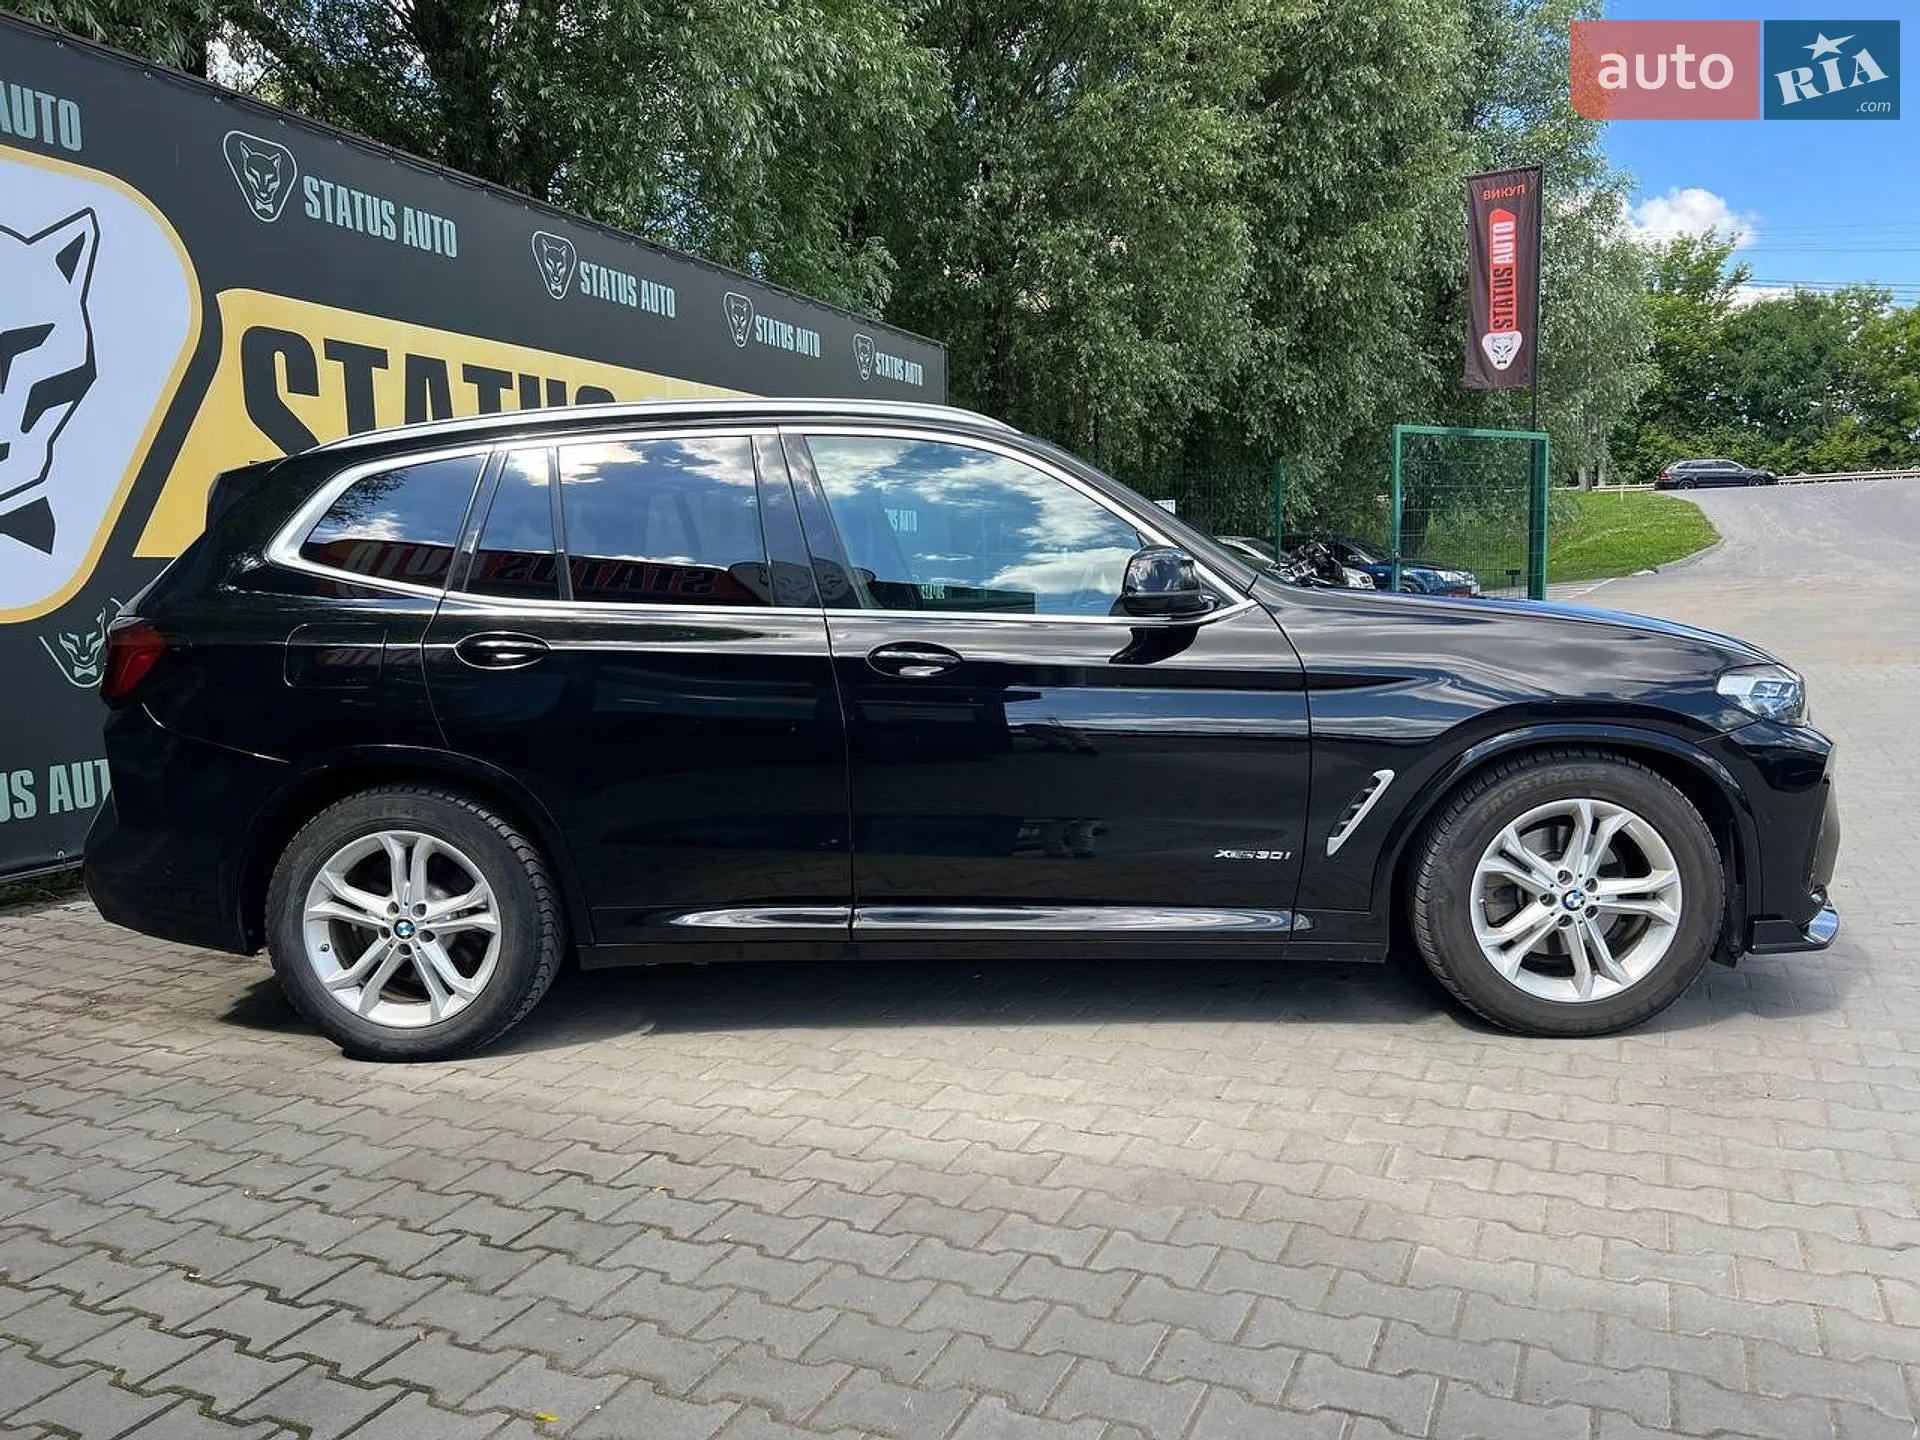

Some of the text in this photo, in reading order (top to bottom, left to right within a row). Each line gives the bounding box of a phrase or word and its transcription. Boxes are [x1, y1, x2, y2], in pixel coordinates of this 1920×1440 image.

[303, 175, 458, 258] STATUS AUTO
[1483, 183, 1527, 201] ВИКУП
[580, 260, 675, 318] STATUS AUTO
[1492, 219, 1515, 330] STATUS AUTO
[755, 315, 821, 359] STATUS AUTO
[875, 351, 923, 387] STATUS AUTO
